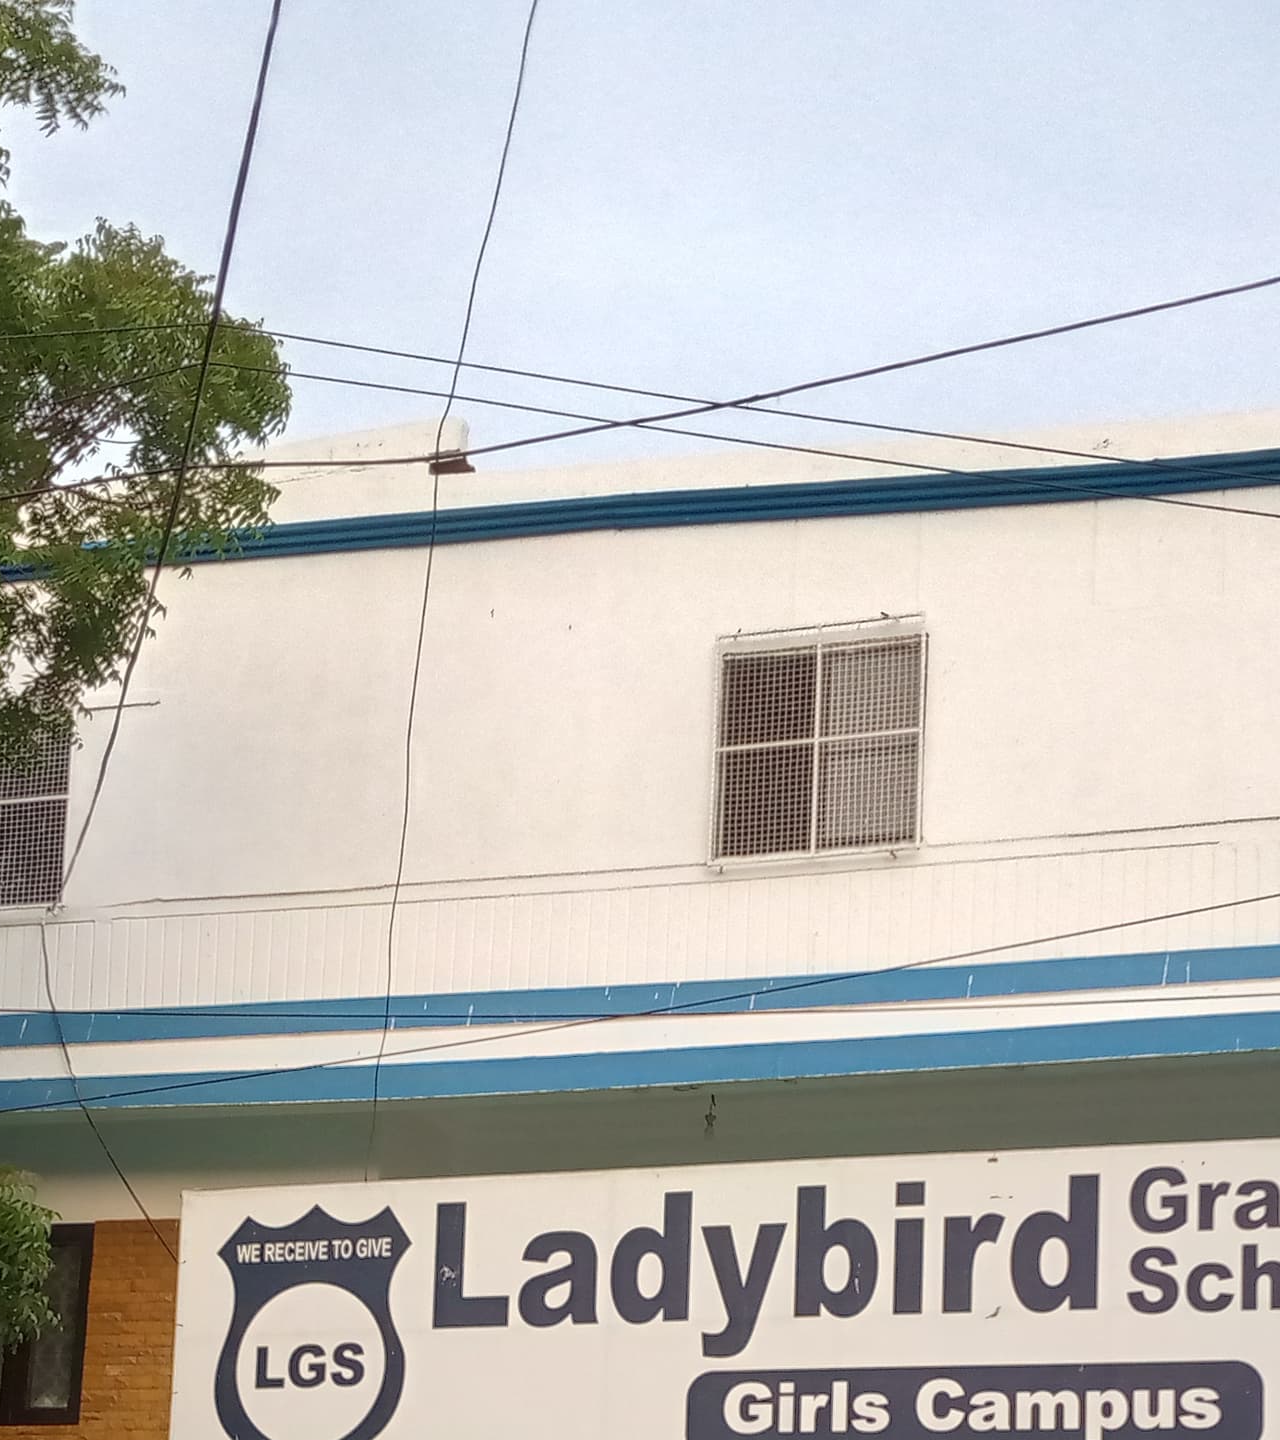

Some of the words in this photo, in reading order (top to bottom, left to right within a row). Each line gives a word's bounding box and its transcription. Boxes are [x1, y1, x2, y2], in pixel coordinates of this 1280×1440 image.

[236, 1243, 261, 1263] WE
[264, 1240, 329, 1262] RECEIVE
[332, 1239, 353, 1259] TO
[356, 1237, 392, 1258] GIVE
[432, 1173, 1100, 1358] Ladybird
[255, 1342, 365, 1388] LGS
[723, 1380, 892, 1434] Girls
